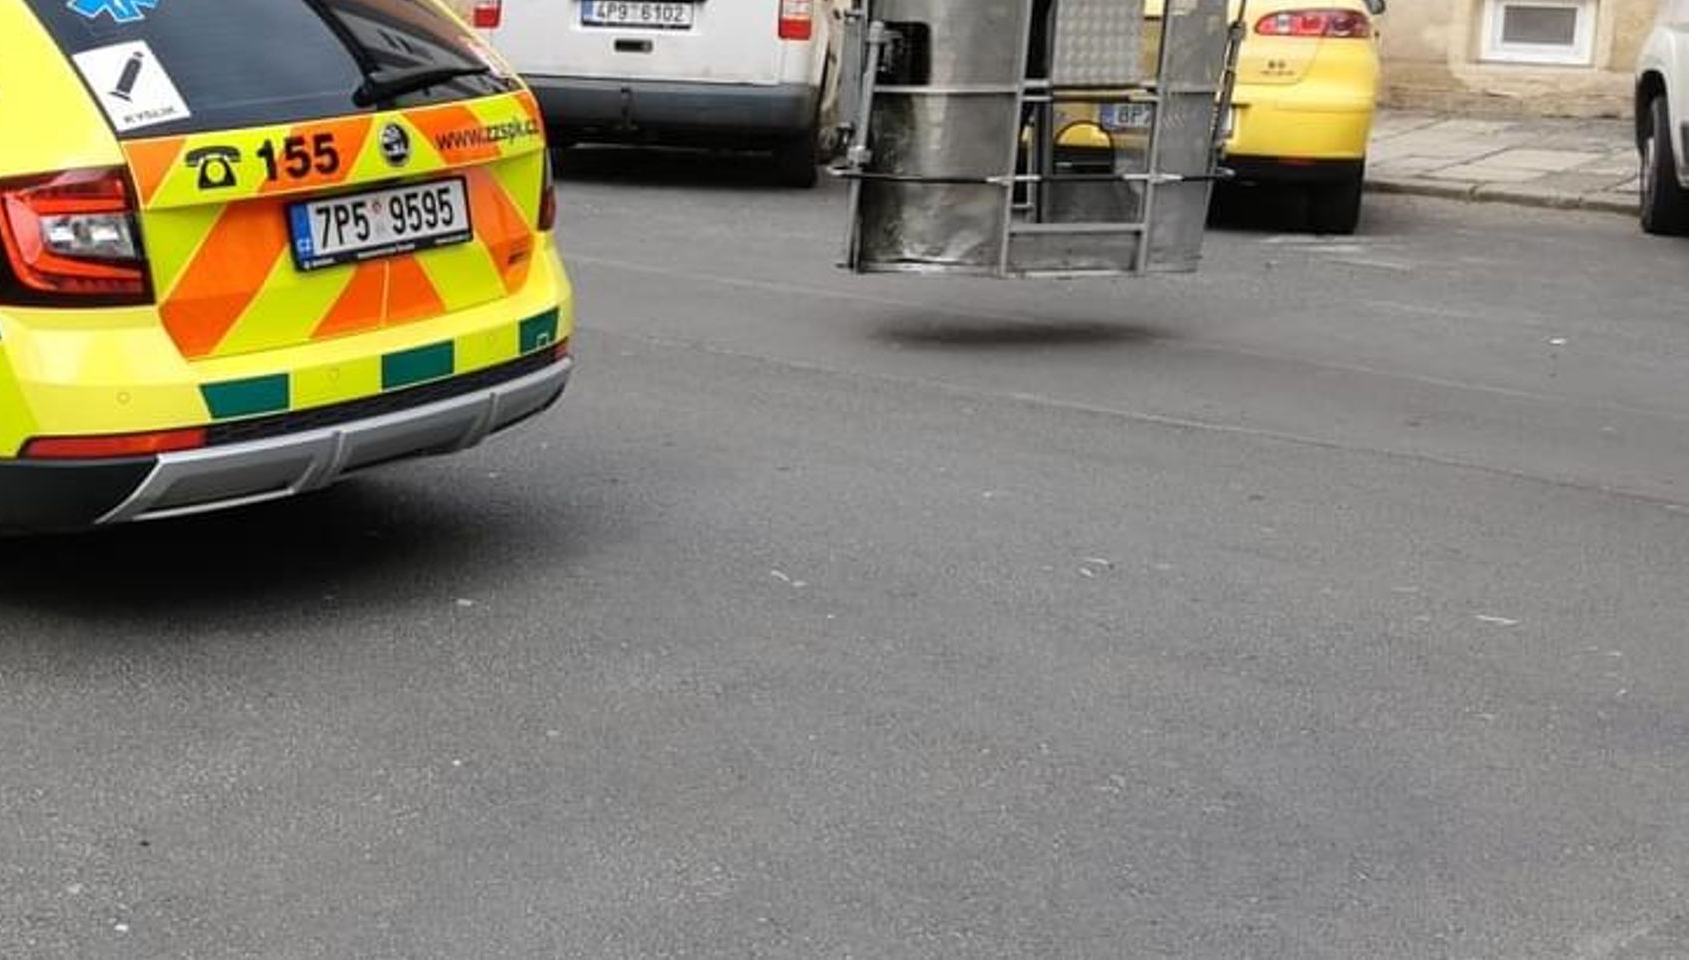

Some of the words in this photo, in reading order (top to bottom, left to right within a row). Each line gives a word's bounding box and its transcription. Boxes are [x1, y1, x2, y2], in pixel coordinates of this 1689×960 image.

[596, 2, 627, 20] 4P9
[641, 3, 684, 22] 6102
[256, 132, 340, 181] 155
[315, 201, 370, 250] 7P5
[389, 187, 454, 235] 9595
